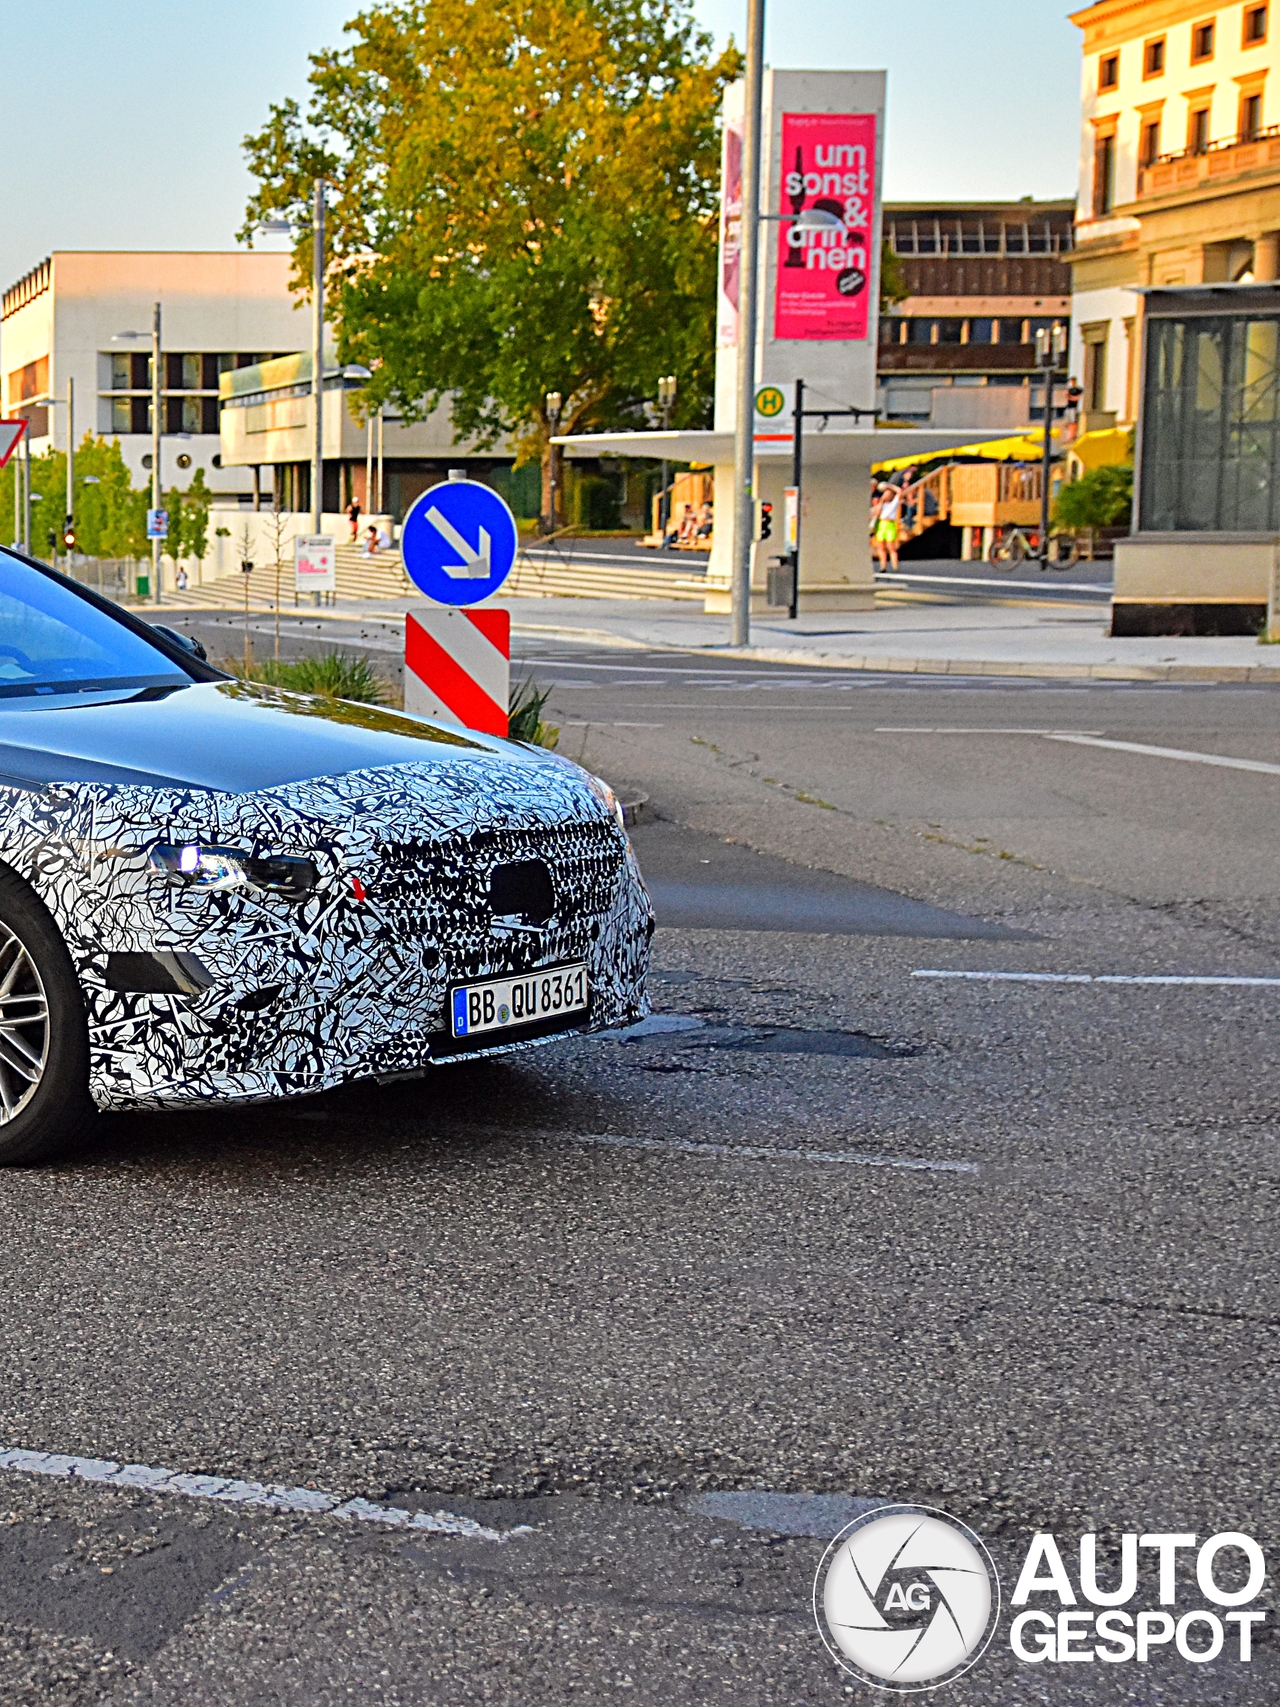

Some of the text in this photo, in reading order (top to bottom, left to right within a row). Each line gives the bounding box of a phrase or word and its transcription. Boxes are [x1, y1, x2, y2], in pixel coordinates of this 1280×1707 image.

[815, 144, 866, 167] um
[786, 168, 869, 196] sonst
[844, 197, 867, 227] &
[807, 247, 866, 270] nen
[763, 394, 776, 409] H
[469, 971, 585, 1026] BB QU 8361
[457, 1016, 463, 1027] D
